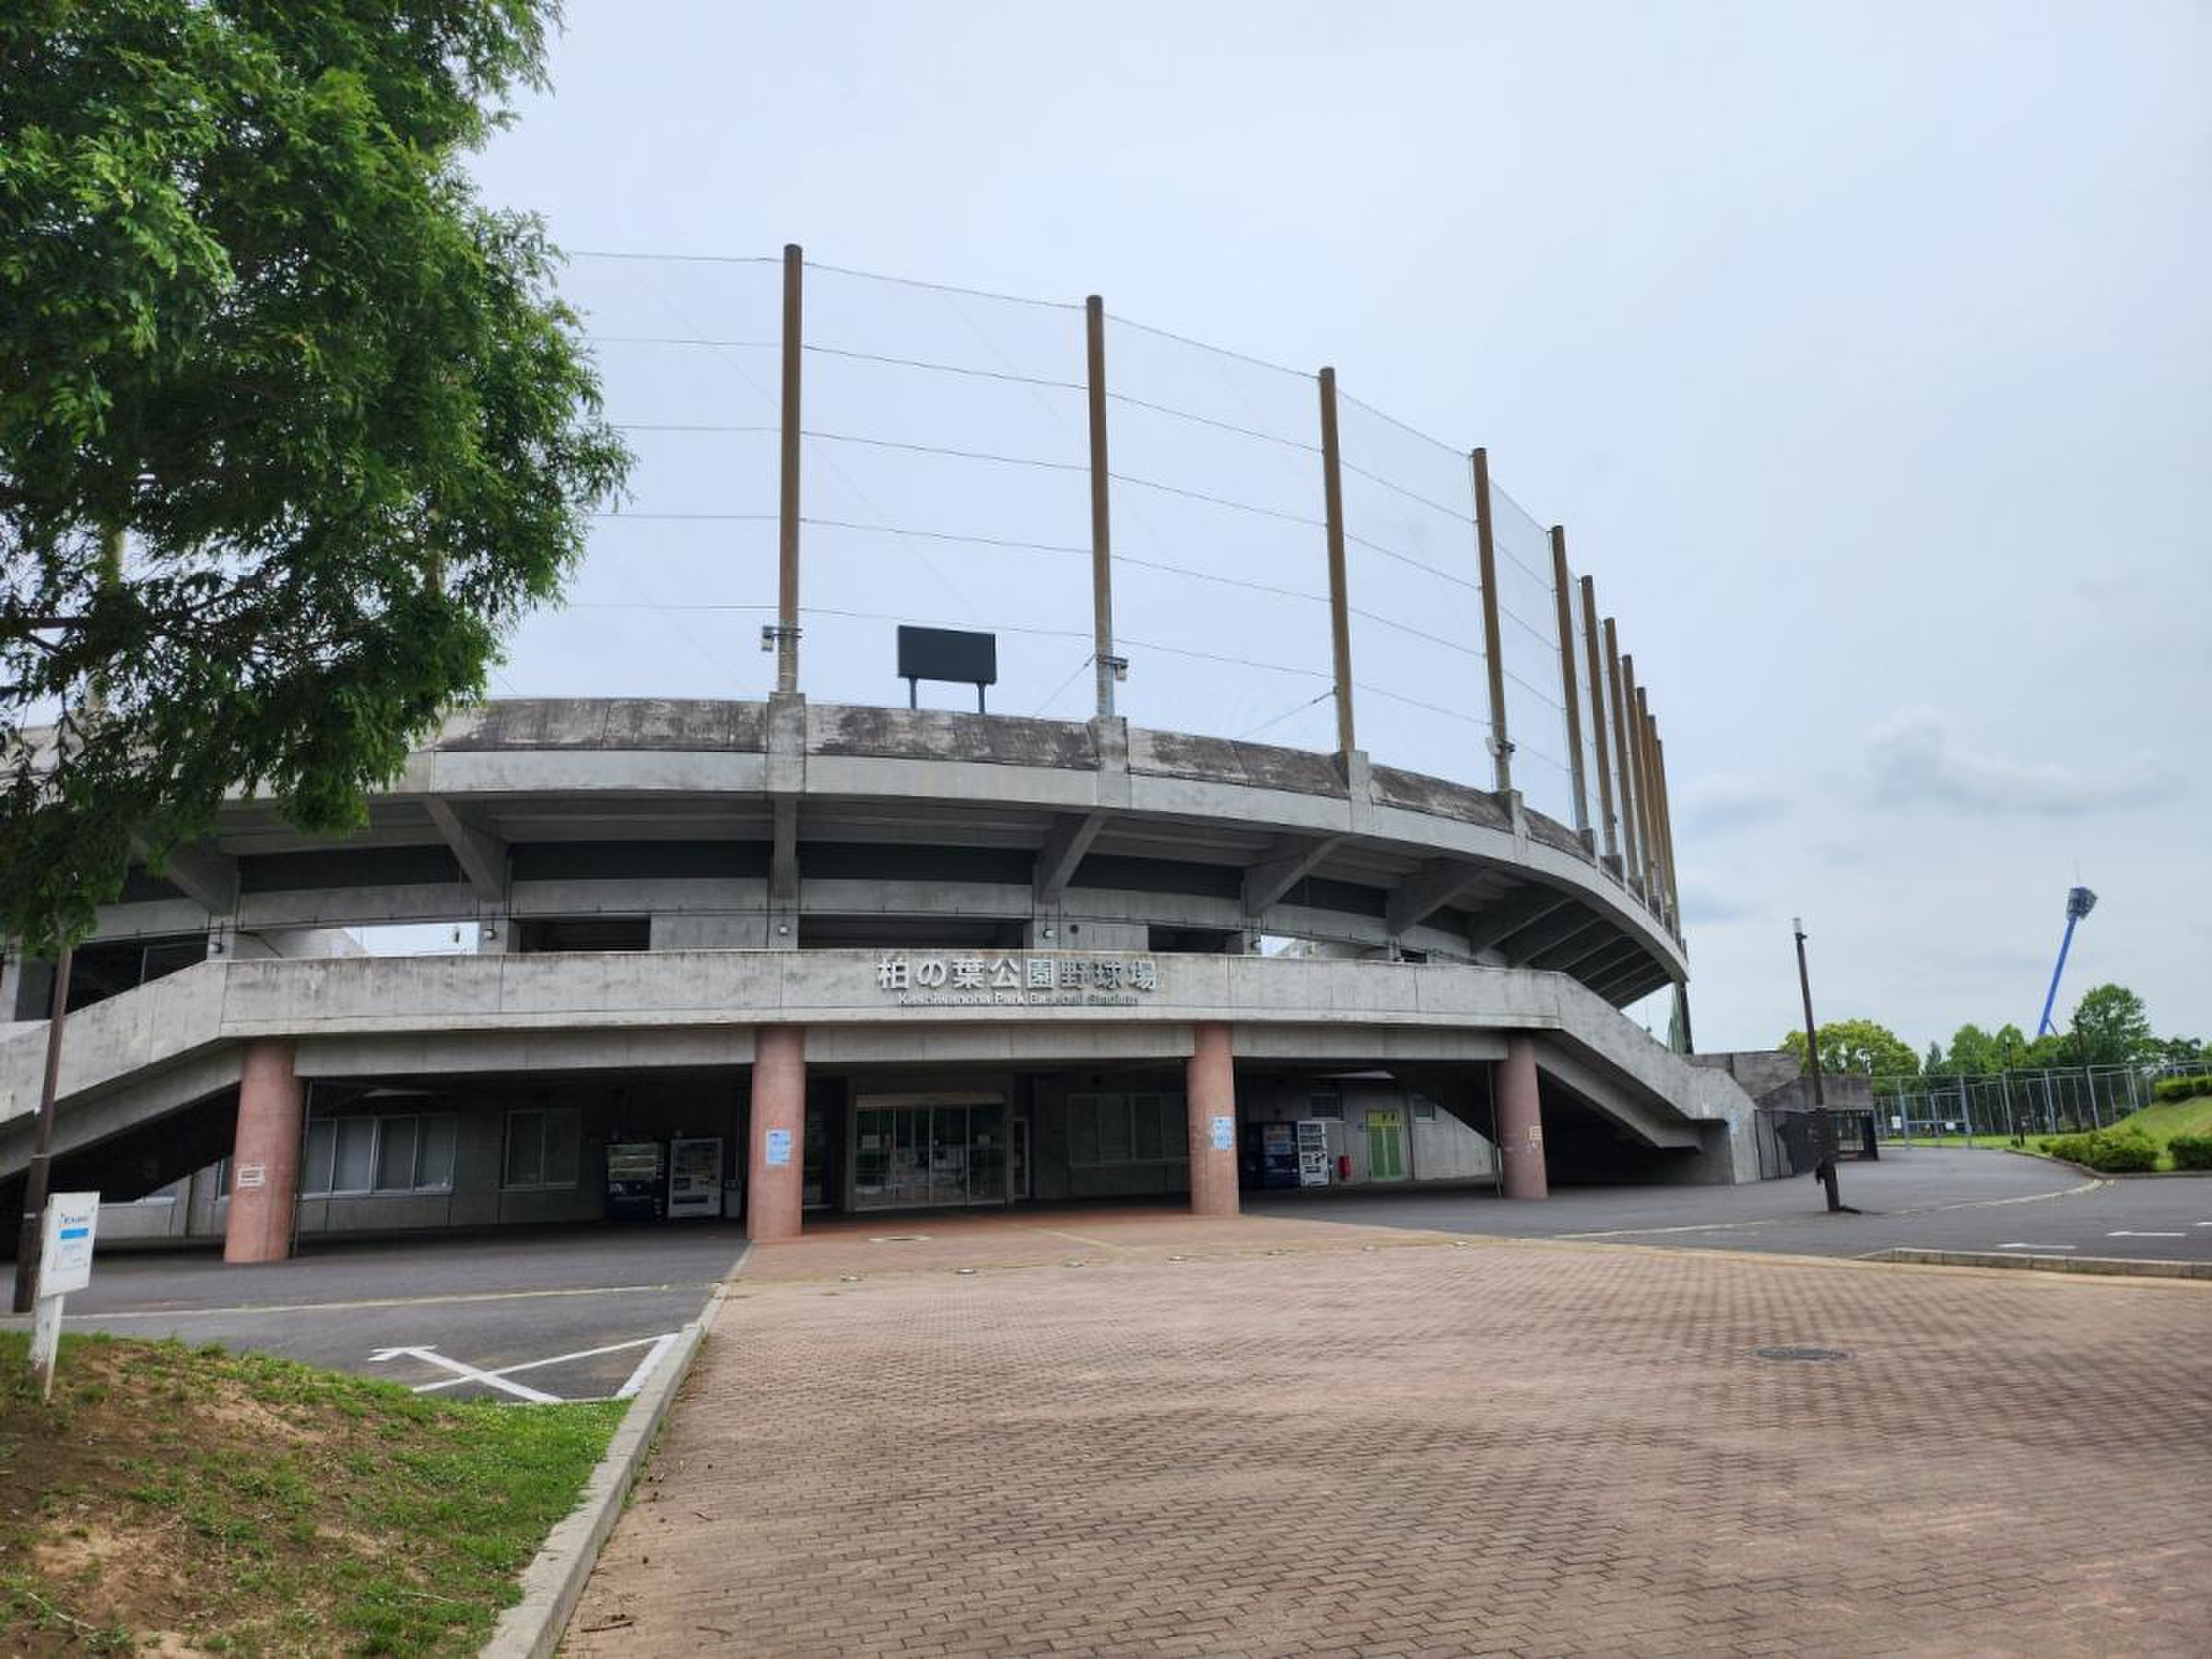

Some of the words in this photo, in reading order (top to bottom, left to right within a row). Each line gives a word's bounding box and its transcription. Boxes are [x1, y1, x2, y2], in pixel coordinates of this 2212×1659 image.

[877, 958, 1158, 990] 柏の葉公園野球場
